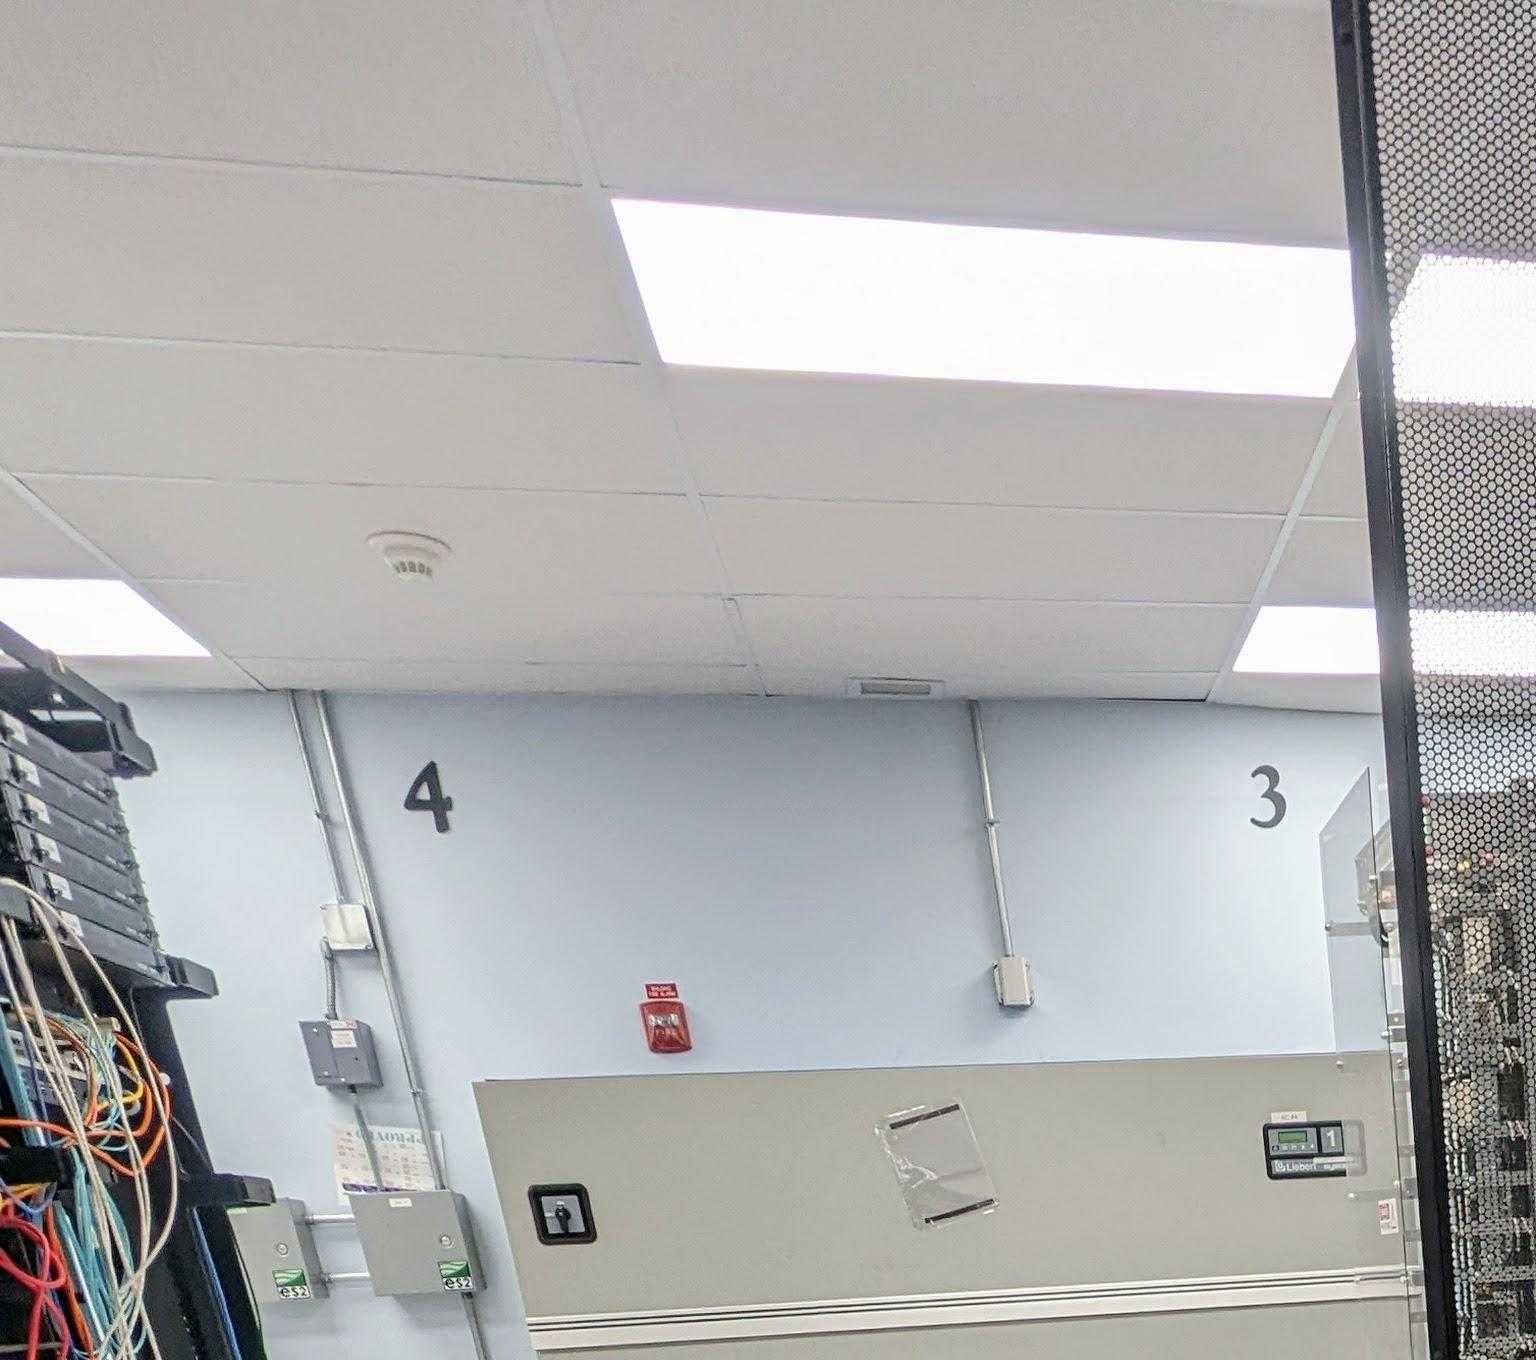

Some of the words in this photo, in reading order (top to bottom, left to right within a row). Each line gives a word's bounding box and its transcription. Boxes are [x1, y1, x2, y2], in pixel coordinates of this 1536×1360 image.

[403, 760, 453, 833] 4
[1250, 765, 1287, 829] 3
[1326, 1129, 1336, 1148] 1
